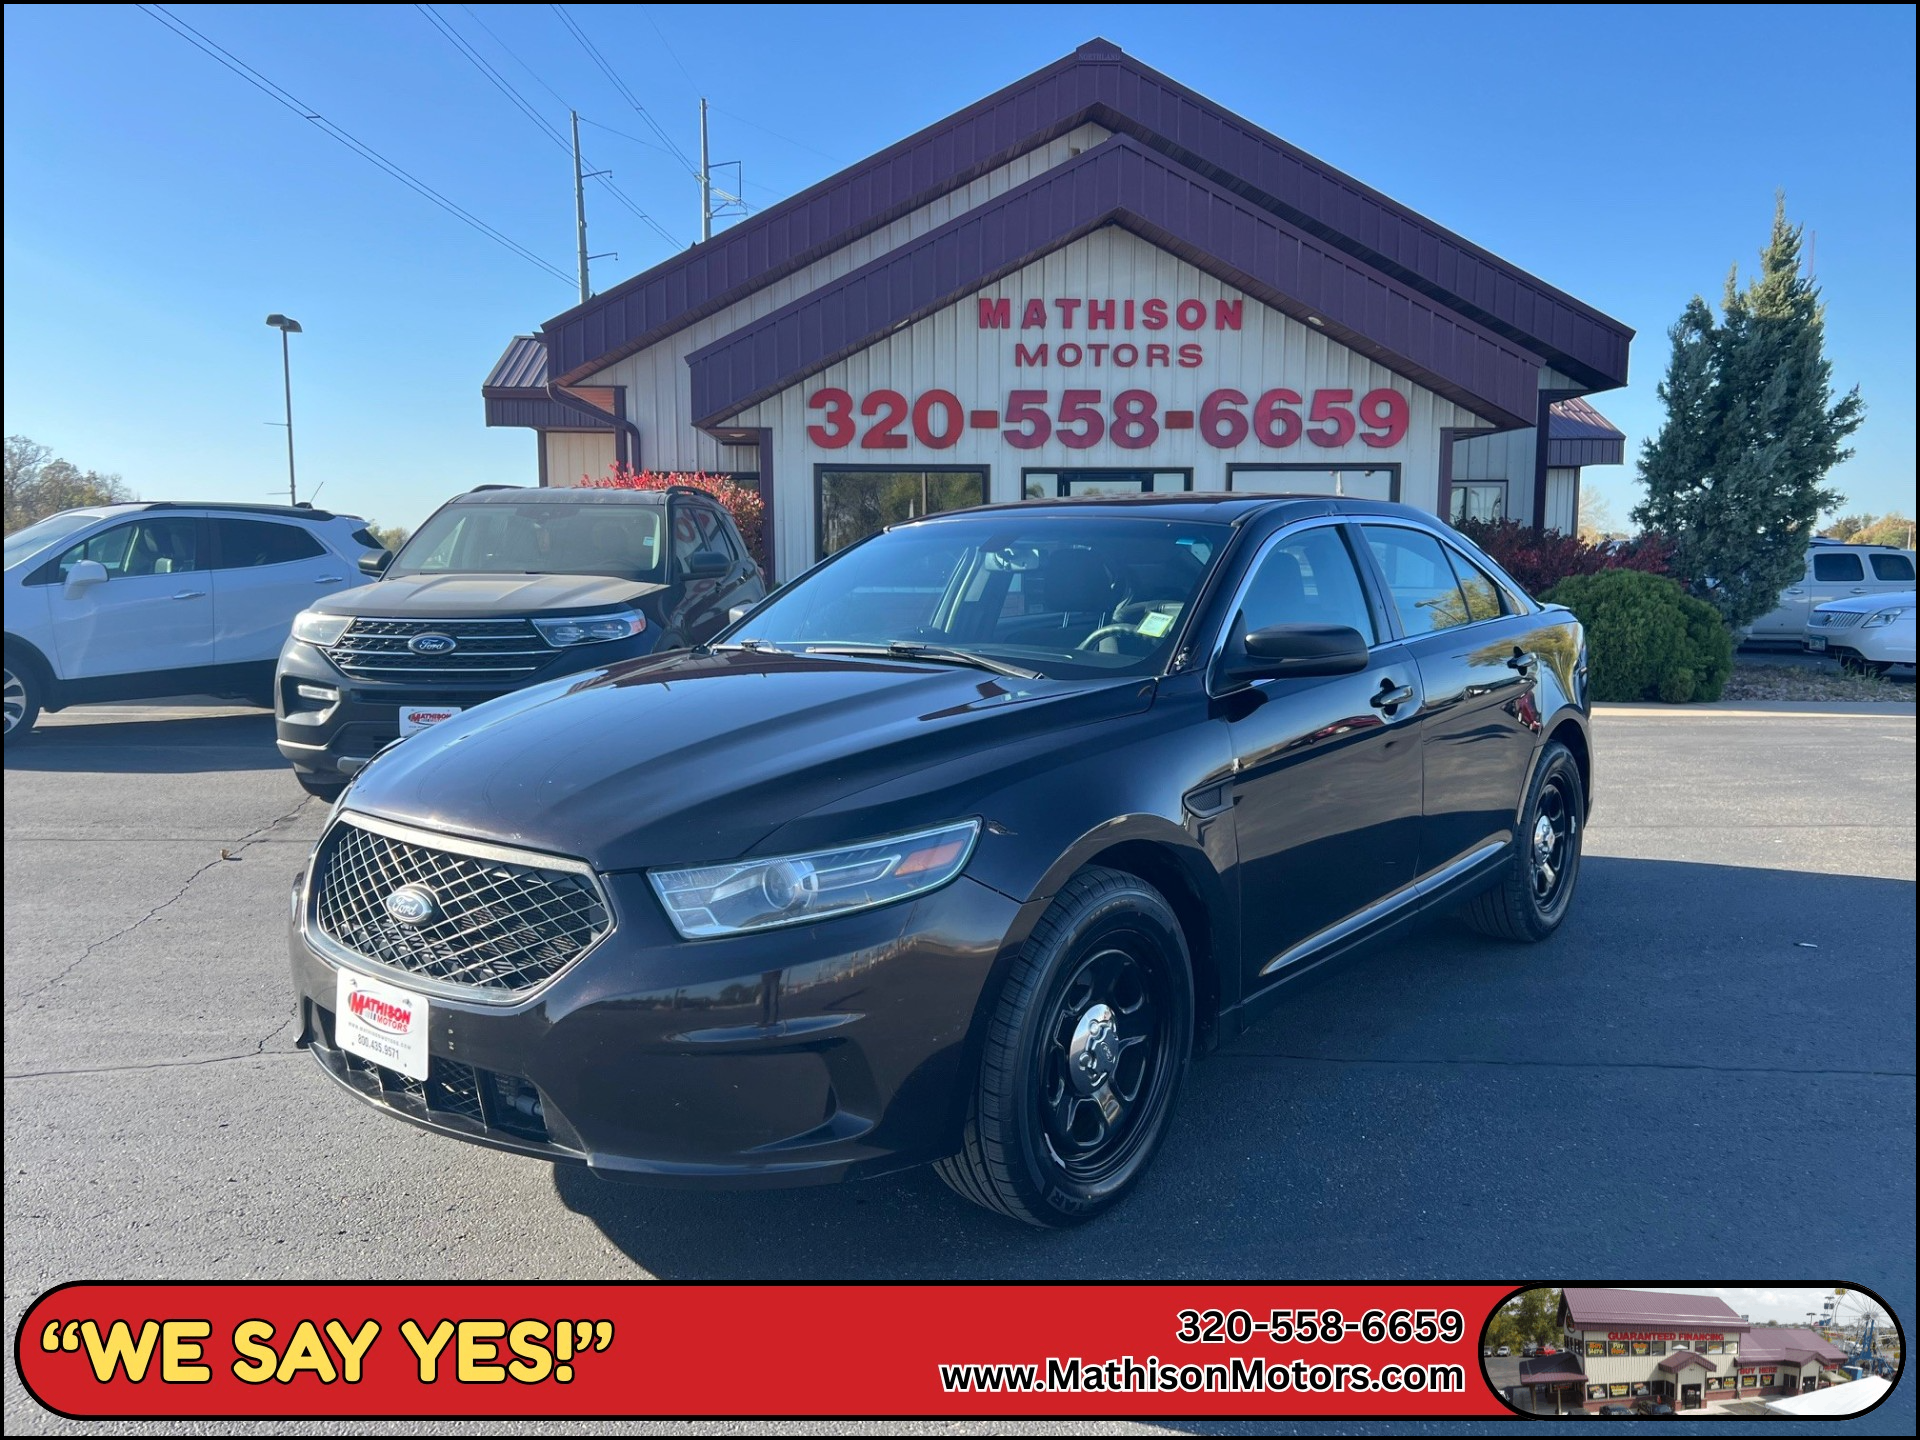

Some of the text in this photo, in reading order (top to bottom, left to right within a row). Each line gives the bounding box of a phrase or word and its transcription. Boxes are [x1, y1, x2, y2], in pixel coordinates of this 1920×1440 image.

[978, 298, 1243, 331] MATHISON
[1015, 343, 1204, 368] MOTORS
[806, 387, 1410, 450] 320-558-6659
[350, 991, 412, 1025] MATHISON
[376, 1015, 408, 1033] MOTORS
[358, 1033, 400, 1060] 800.435.9571
